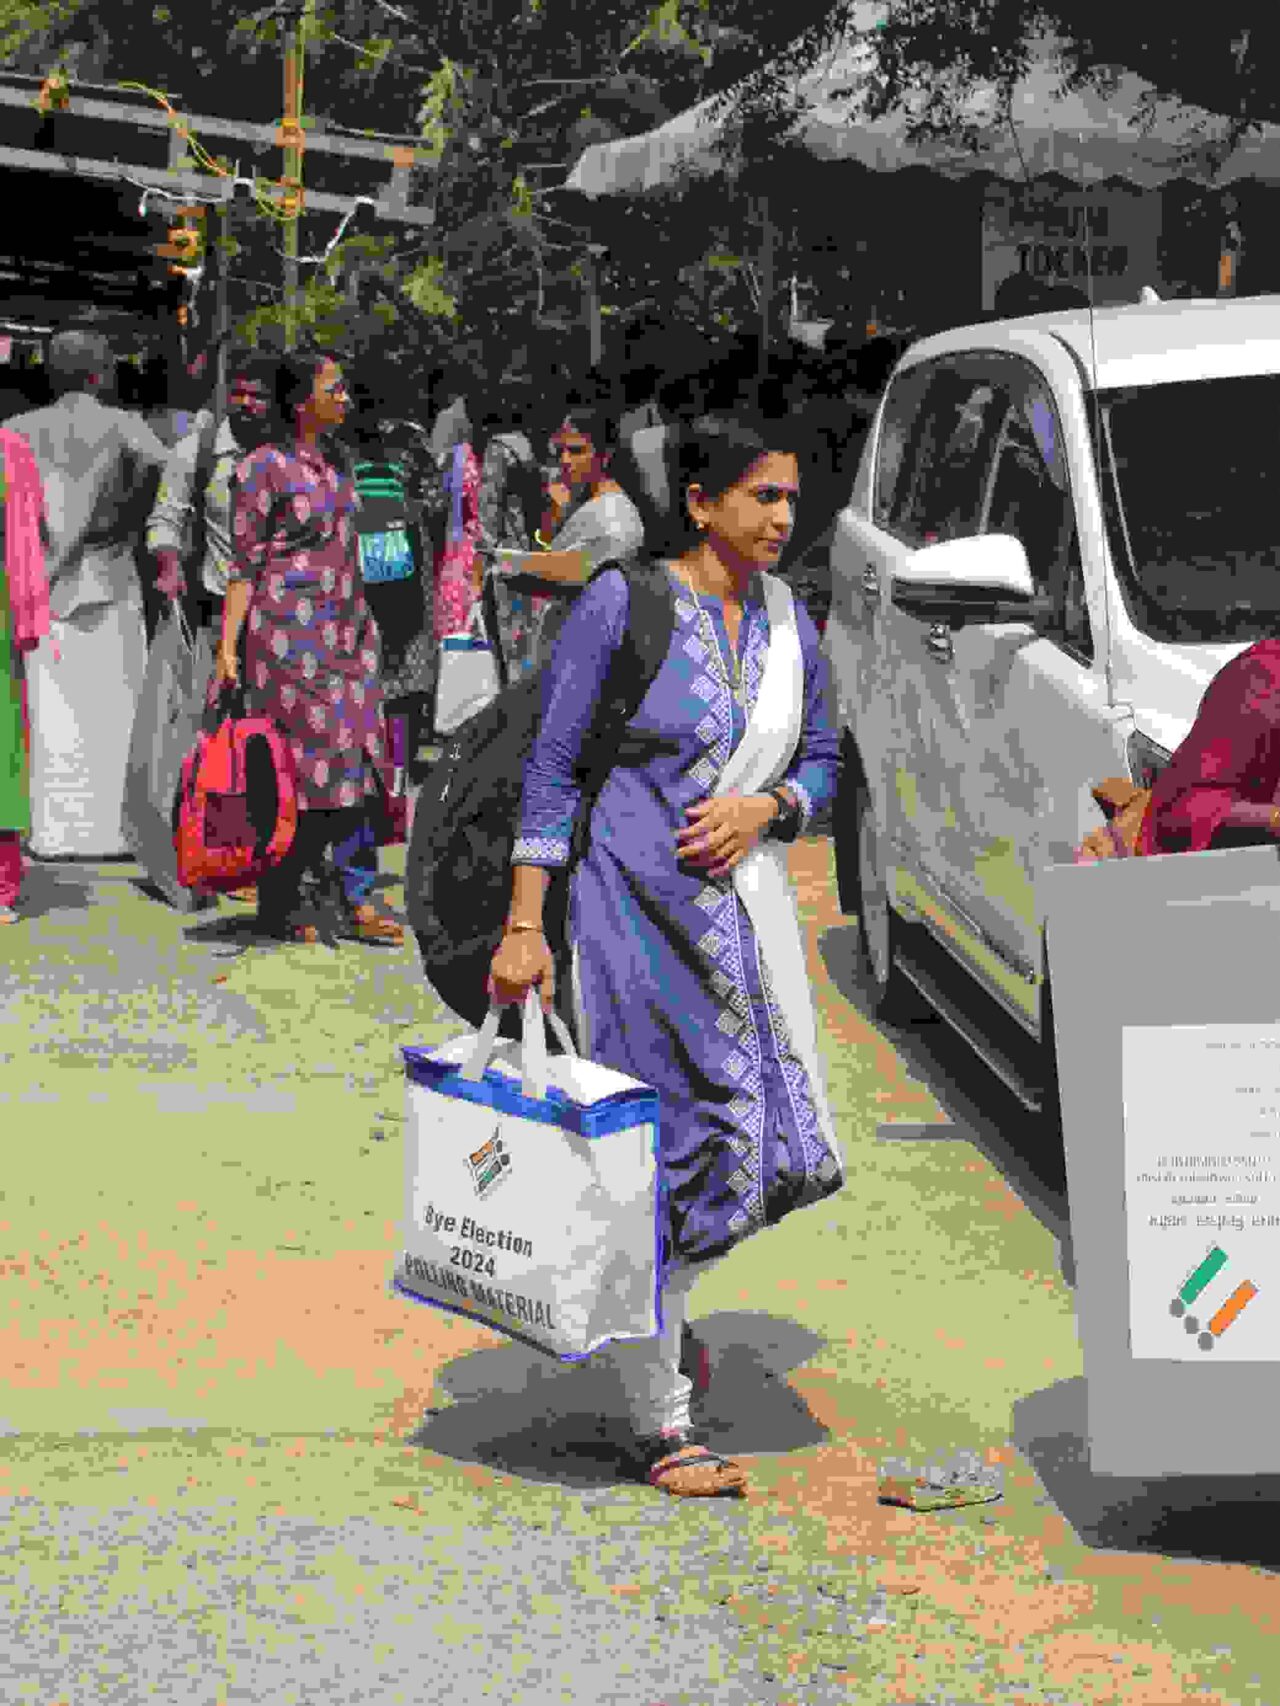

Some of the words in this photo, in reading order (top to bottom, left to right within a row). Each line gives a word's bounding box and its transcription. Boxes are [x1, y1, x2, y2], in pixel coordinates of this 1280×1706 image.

[425, 1204, 456, 1232] Bye
[460, 1216, 533, 1258] Election
[450, 1246, 495, 1278] 2024
[469, 1279, 556, 1330] MATERIAL
